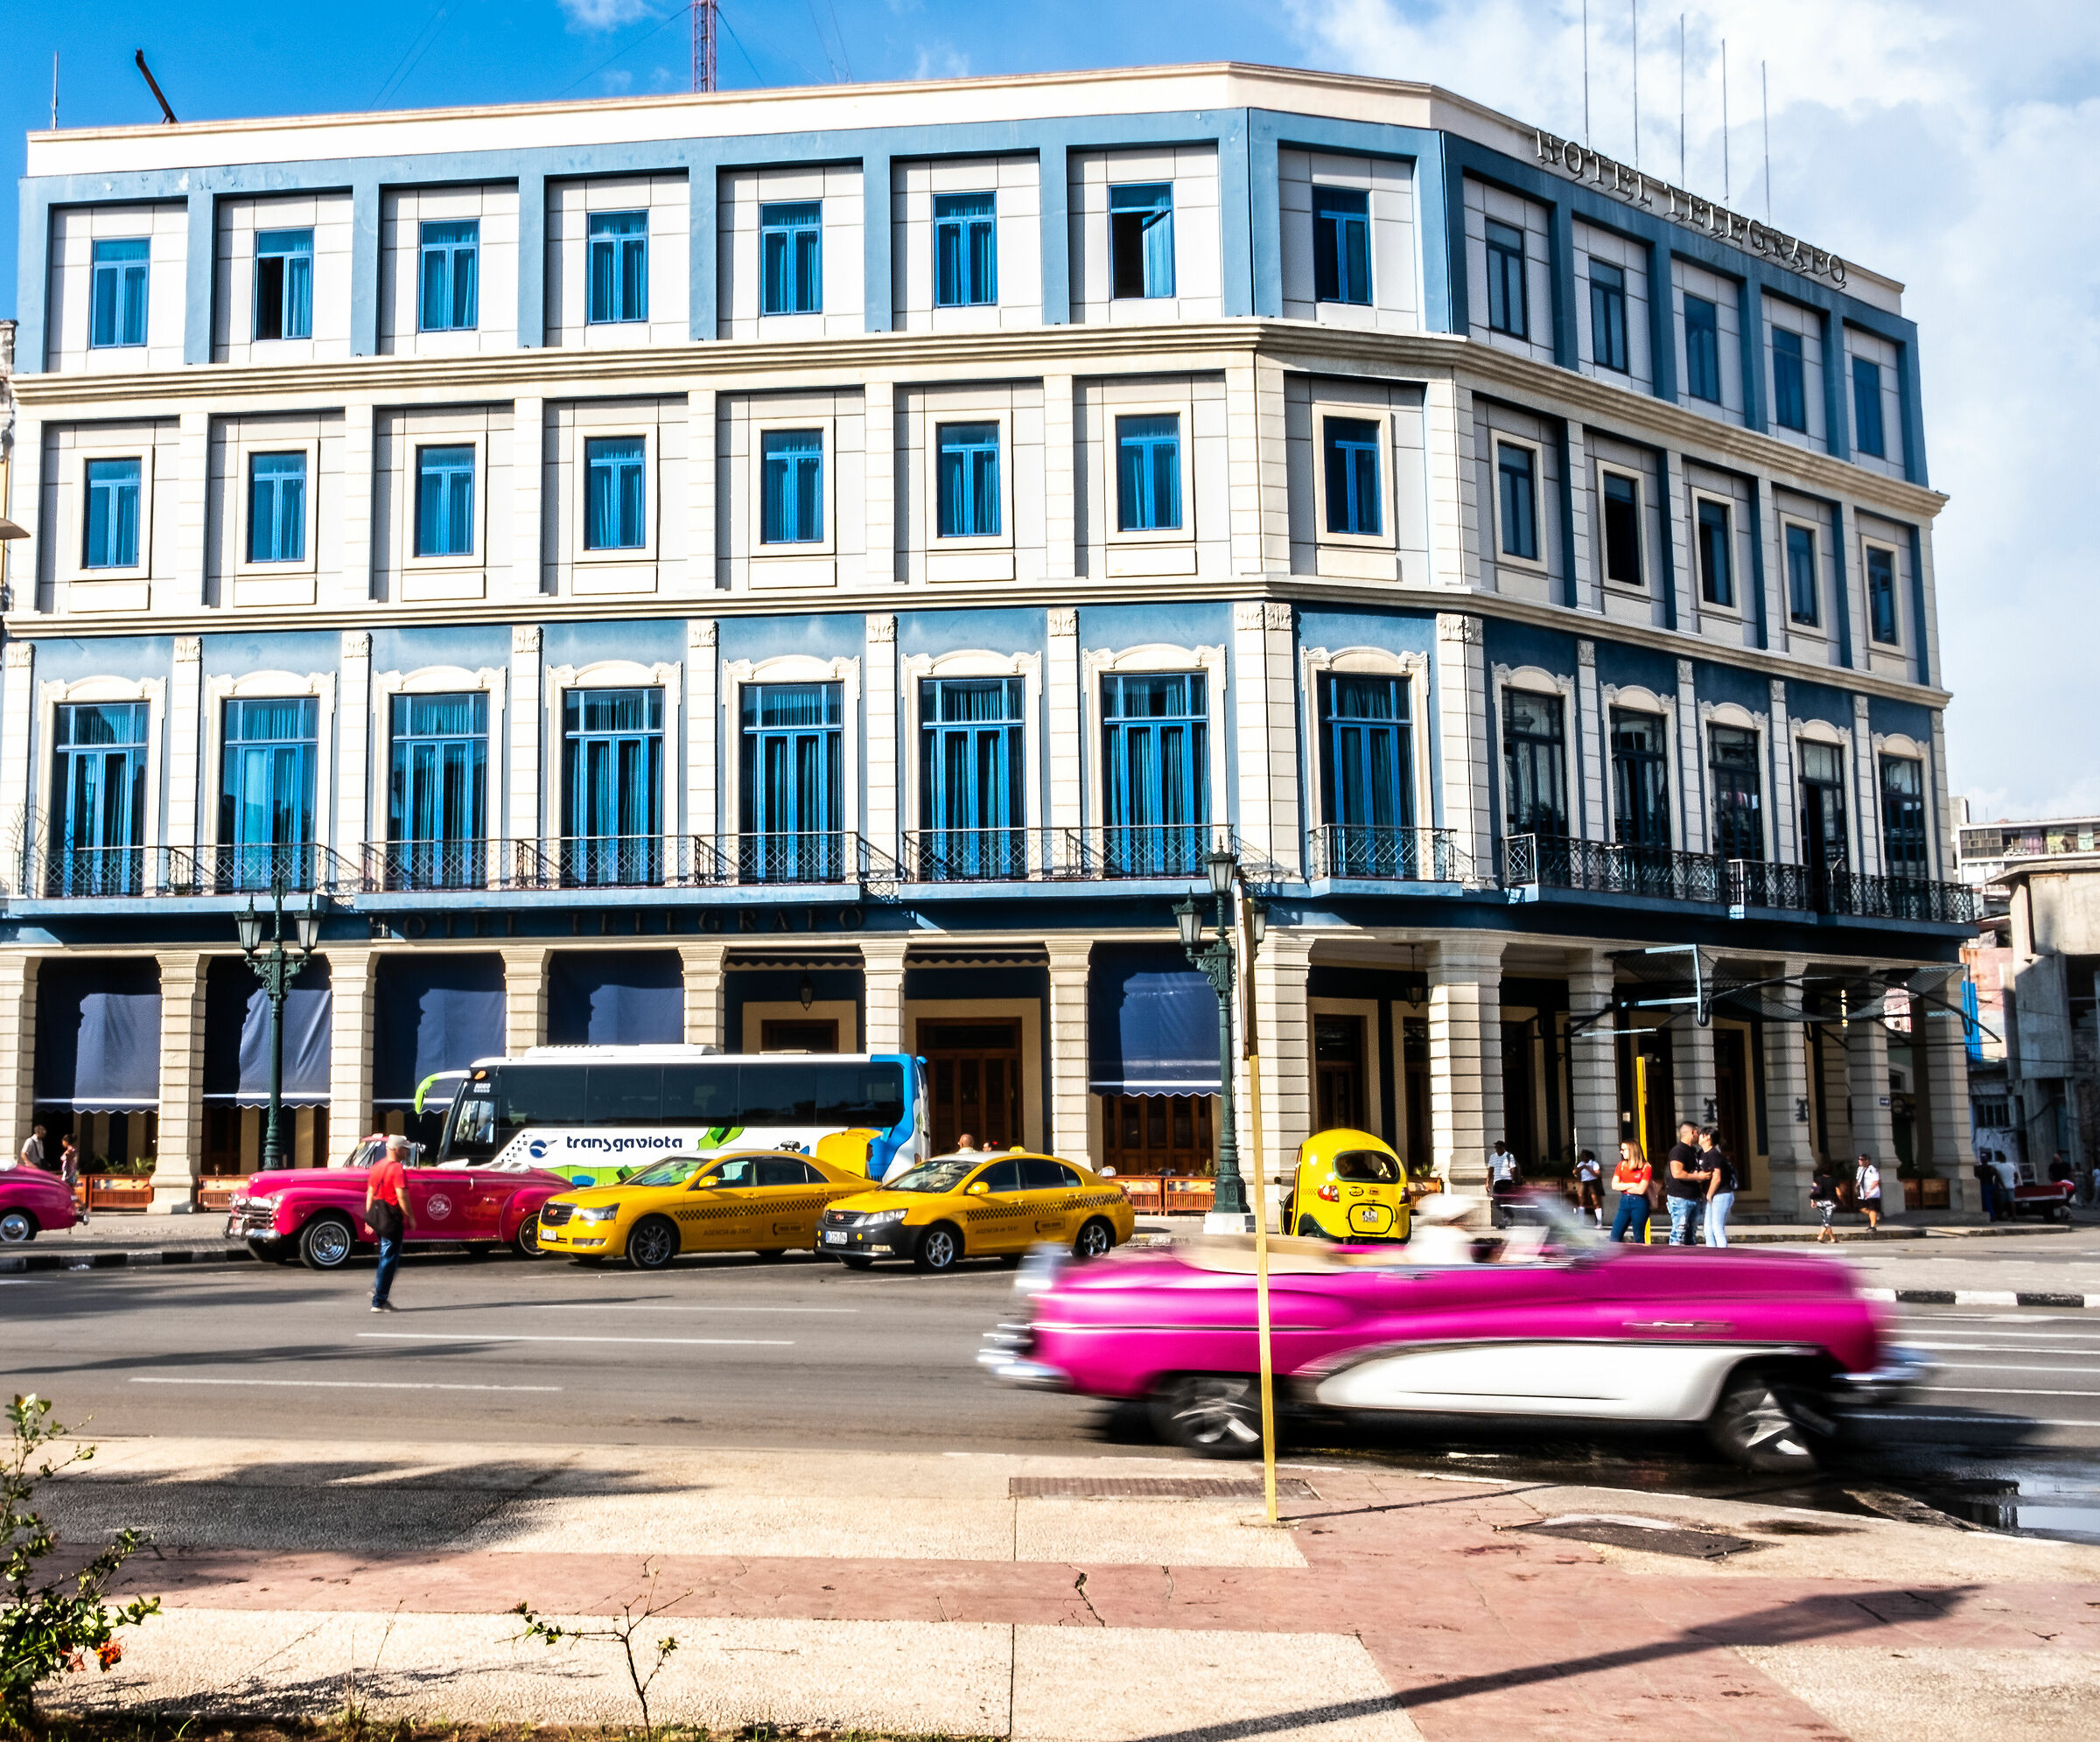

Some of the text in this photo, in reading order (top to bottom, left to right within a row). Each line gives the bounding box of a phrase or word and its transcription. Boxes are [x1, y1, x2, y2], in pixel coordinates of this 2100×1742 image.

[1536, 127, 1847, 284] HOTEL TELEGRAFO
[368, 906, 864, 939] HOTEL TELEGRAFO
[566, 1136, 682, 1152] transgaviota
